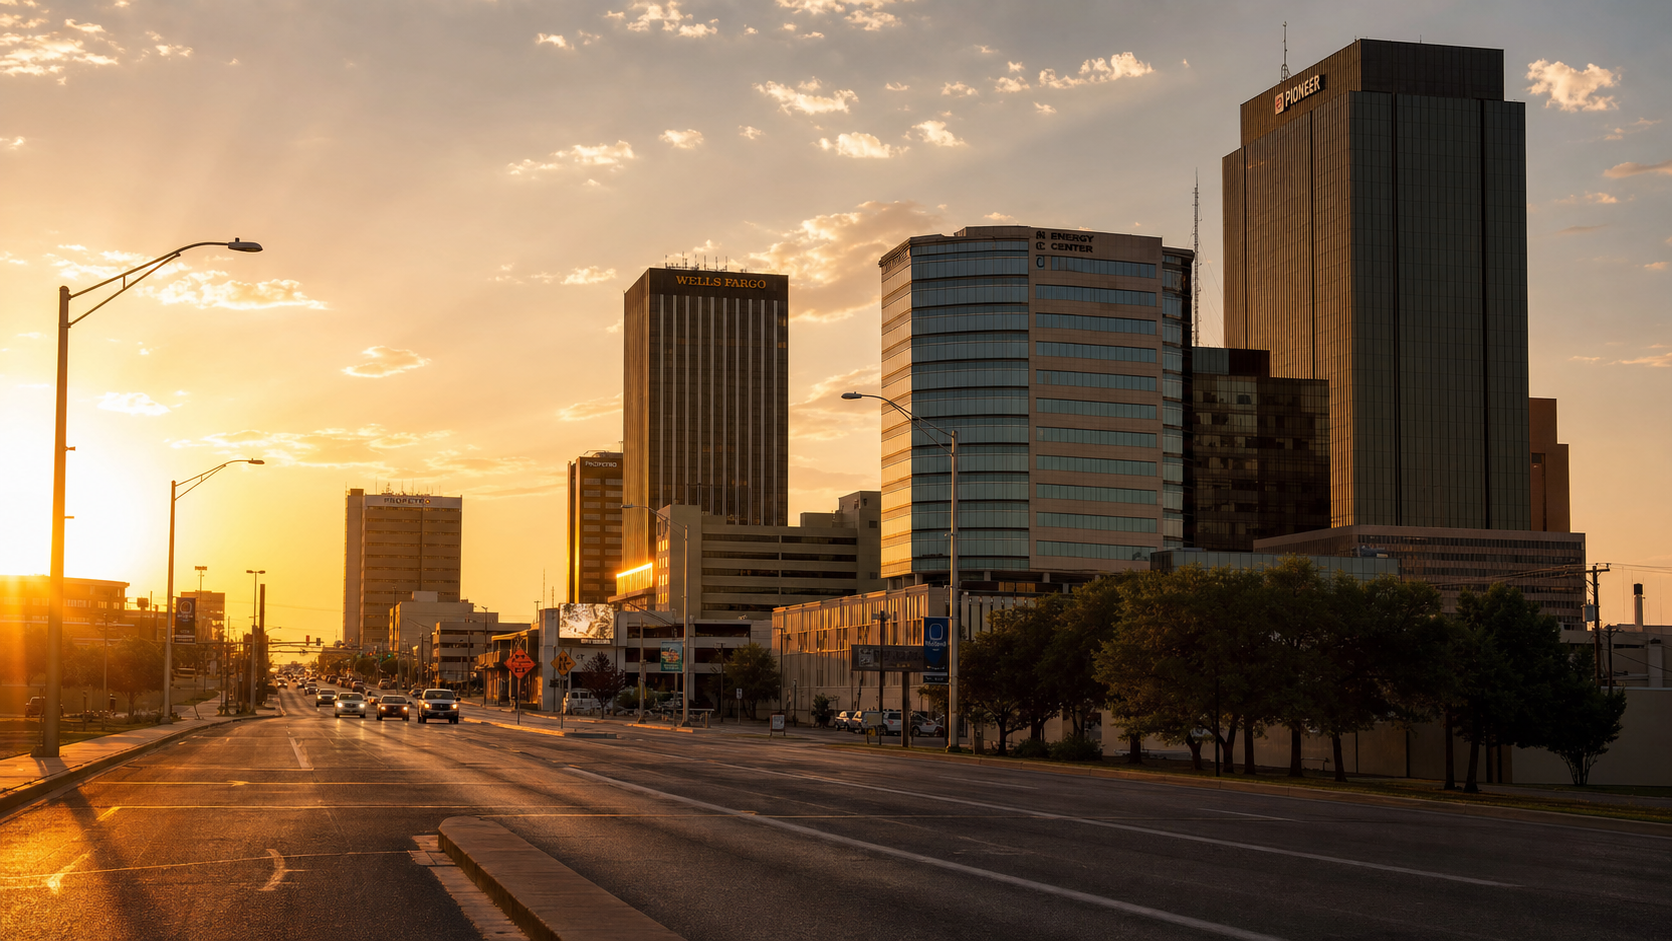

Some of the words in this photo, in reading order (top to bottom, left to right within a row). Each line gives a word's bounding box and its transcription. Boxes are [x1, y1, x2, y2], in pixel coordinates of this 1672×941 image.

[1285, 74, 1321, 107] PIONEER
[1050, 232, 1095, 243] ENERGY
[1050, 242, 1093, 253] CENTER
[676, 275, 722, 287] WELLS
[724, 277, 767, 289] FARGO
